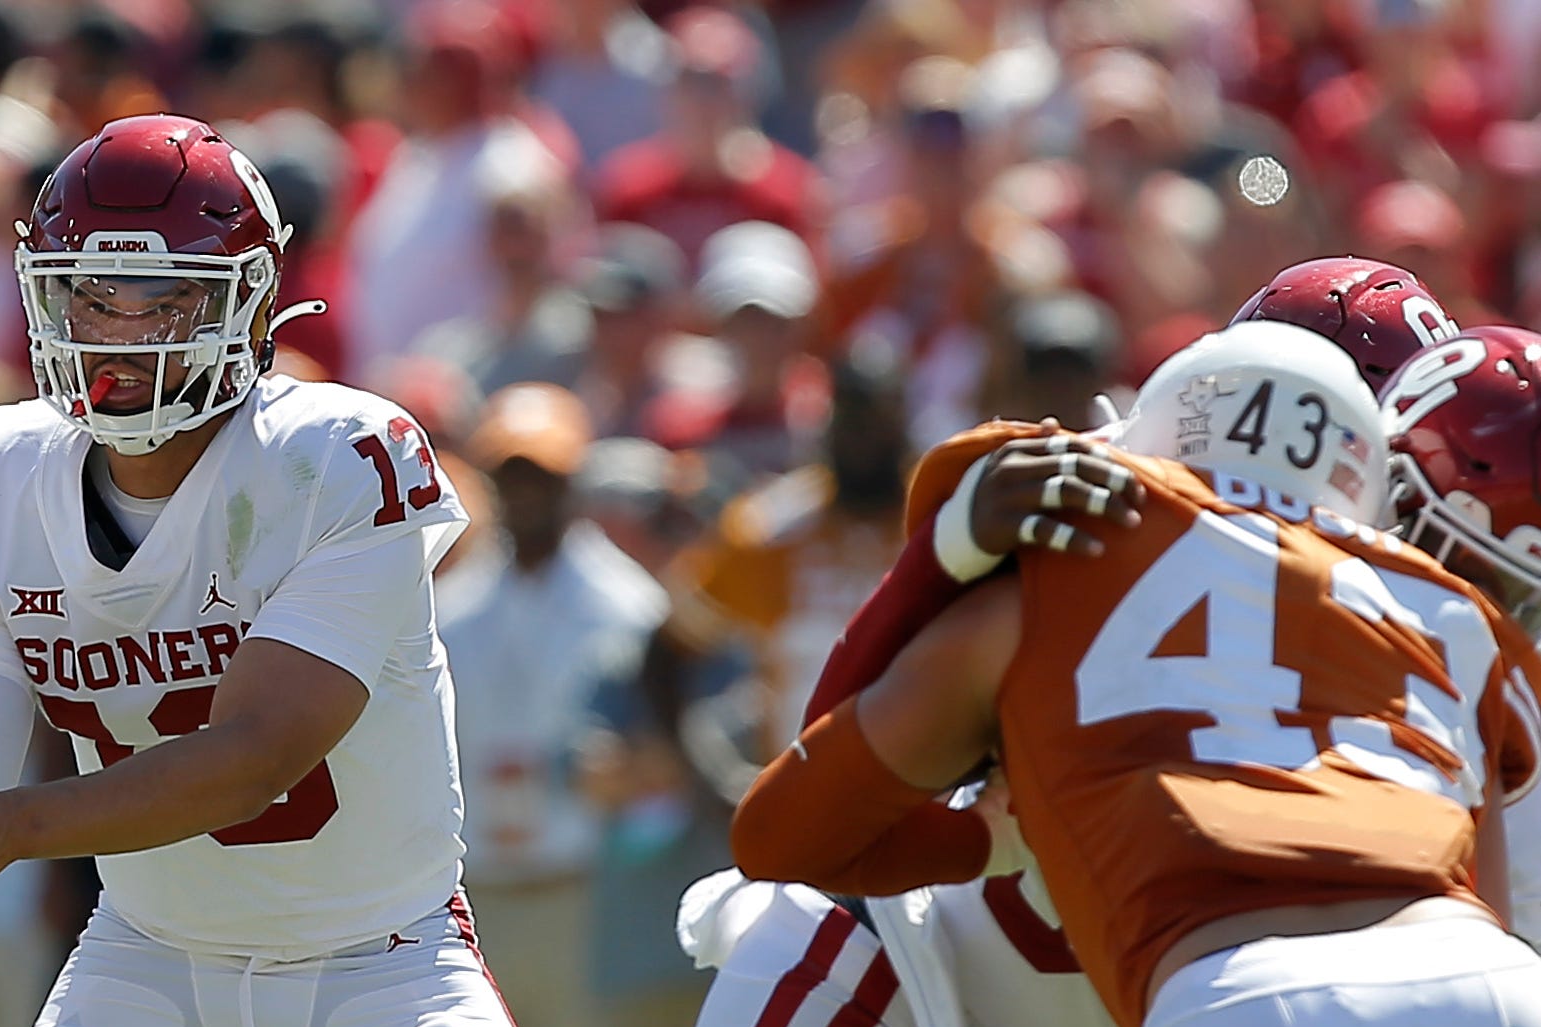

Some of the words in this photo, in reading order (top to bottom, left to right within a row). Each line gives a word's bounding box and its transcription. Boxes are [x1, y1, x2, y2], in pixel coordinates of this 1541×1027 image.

[1226, 378, 1328, 470] 43
[351, 416, 442, 528] 13
[10, 587, 66, 619] XII
[15, 619, 253, 692] SOONER
[1074, 509, 1500, 808] 43
